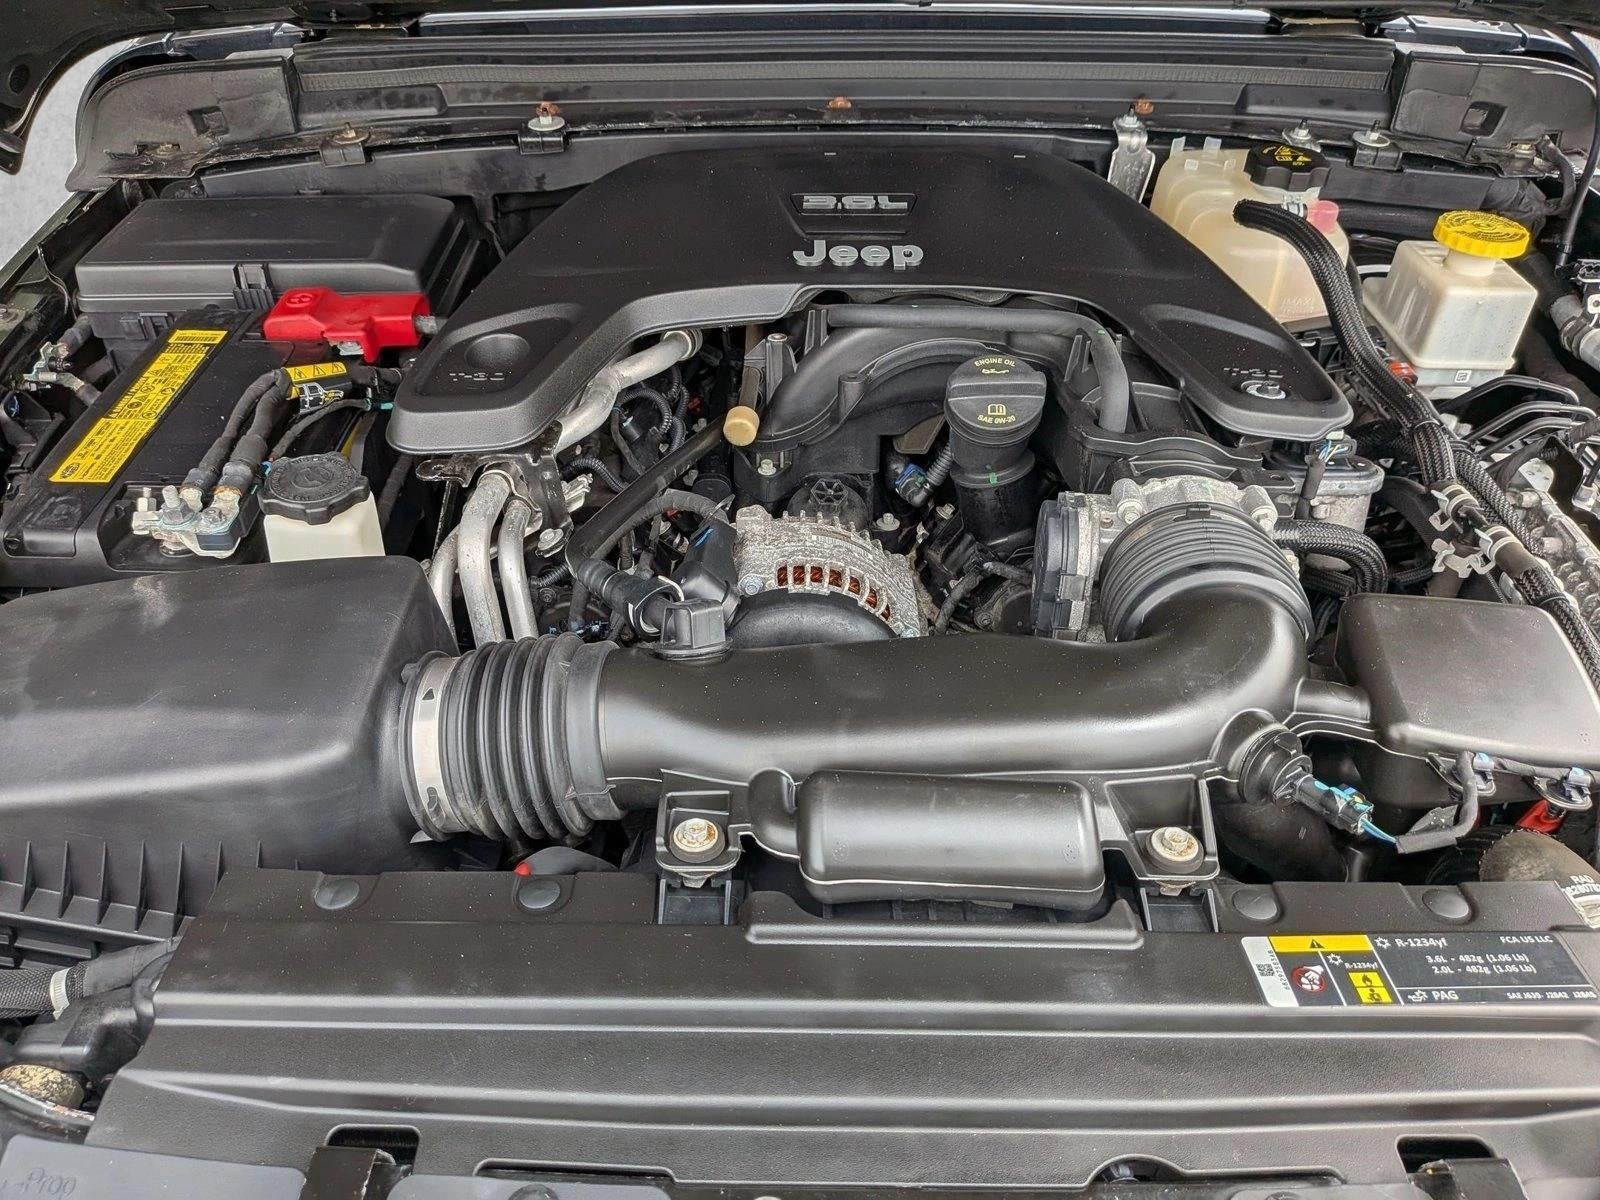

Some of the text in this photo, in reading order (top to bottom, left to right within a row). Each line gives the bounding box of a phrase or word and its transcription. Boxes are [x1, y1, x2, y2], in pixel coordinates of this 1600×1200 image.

[802, 195, 908, 210] 3.6L
[792, 239, 924, 271] Jeep
[974, 358, 1016, 368] ENGINE OIL
[977, 414, 1016, 424] SAE 0W-20
[1570, 874, 1595, 884] RAD
[1394, 937, 1448, 949] R-1234yf
[1500, 936, 1520, 944] FCA
[1535, 935, 1553, 943] LLC
[1425, 955, 1448, 963] 3.6L
[1459, 954, 1484, 964] 482g
[1486, 953, 1512, 963] (1.06
[1512, 953, 1530, 962] Lb)
[1432, 966, 1454, 974] 2.0L
[1465, 965, 1491, 974] 482g
[1493, 964, 1519, 974] (1.06
[1519, 964, 1537, 974] Lb)
[1431, 990, 1459, 1000] PAG
